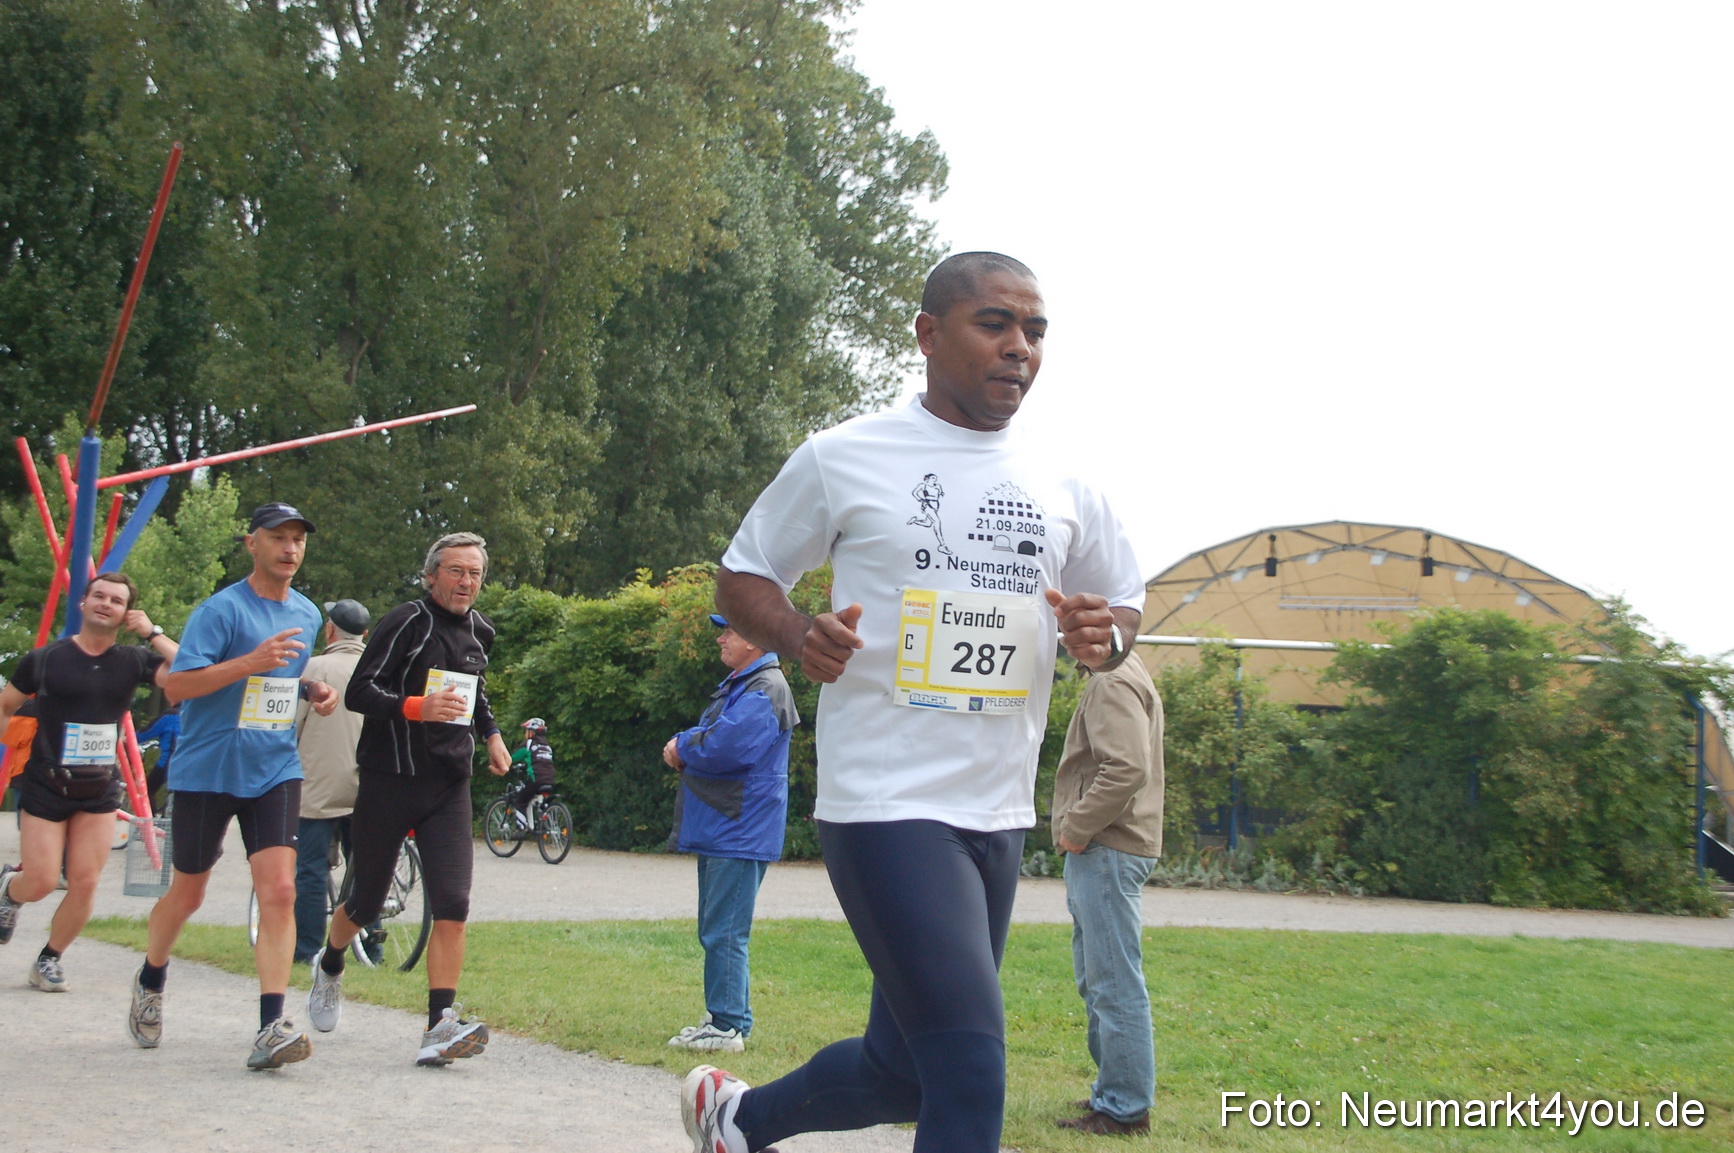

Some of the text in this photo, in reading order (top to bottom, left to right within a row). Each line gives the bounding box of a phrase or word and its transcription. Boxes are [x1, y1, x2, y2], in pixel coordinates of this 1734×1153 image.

[976, 518, 1046, 537] 21.09.2008
[914, 548, 1041, 579] 9. Neumarkter
[970, 573, 1039, 595] Stadtlauf
[941, 602, 1006, 629] Evando
[904, 633, 914, 650] C
[950, 641, 1017, 676] 287
[263, 682, 295, 694] Bernhard
[266, 699, 291, 714] 907
[984, 697, 1027, 708] PFLEIDERER
[82, 739, 112, 752] 3003
